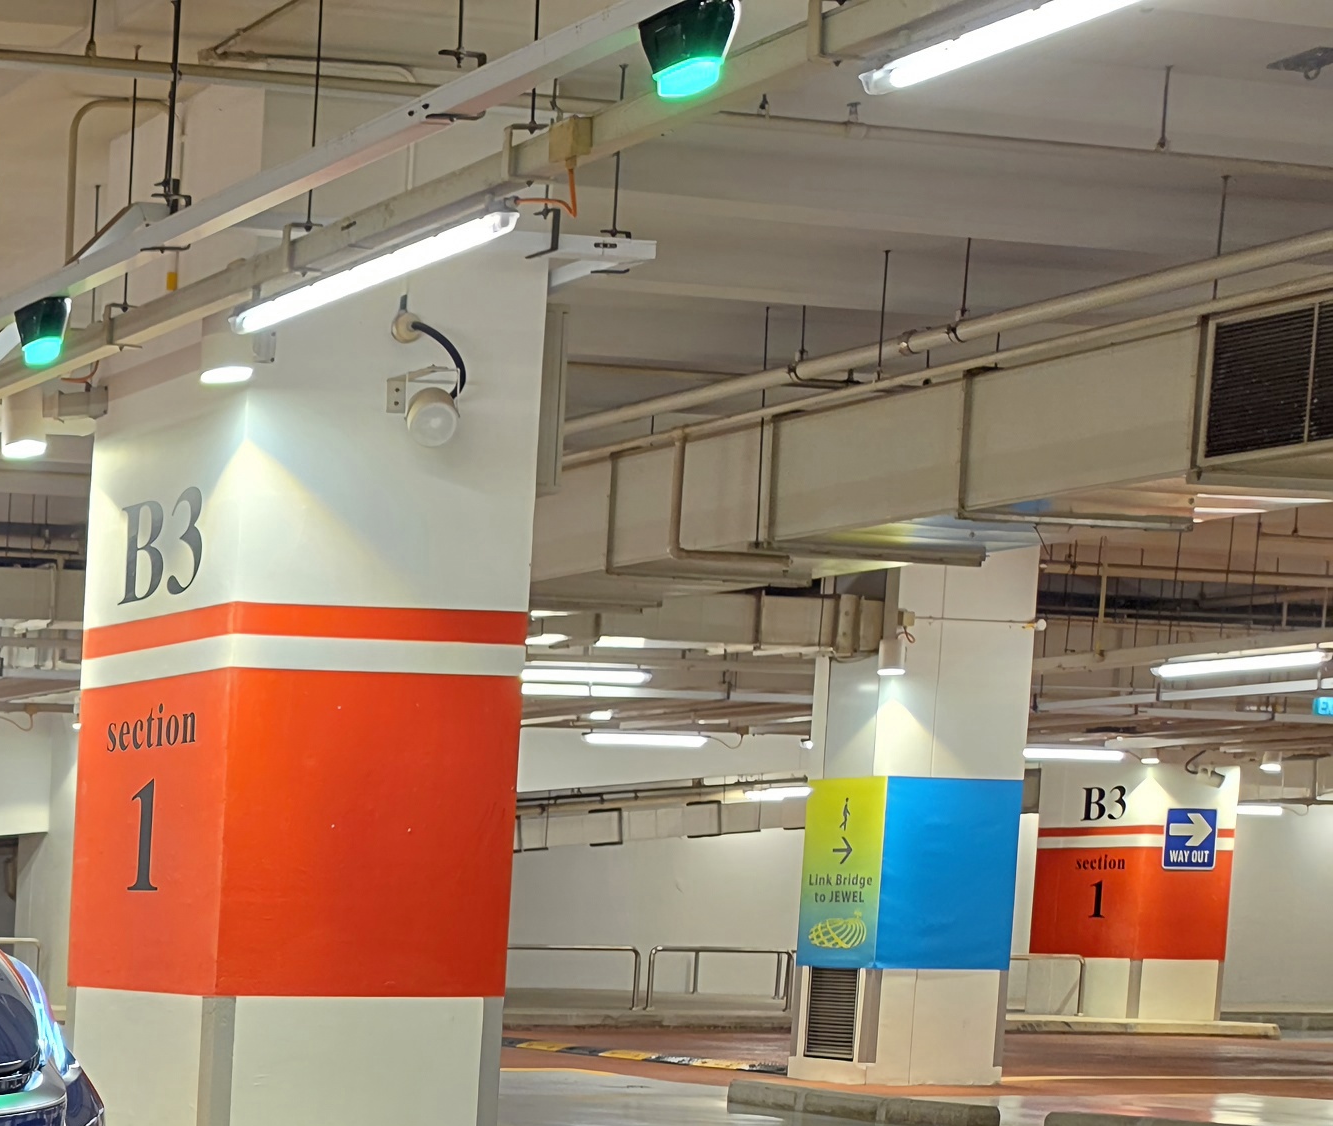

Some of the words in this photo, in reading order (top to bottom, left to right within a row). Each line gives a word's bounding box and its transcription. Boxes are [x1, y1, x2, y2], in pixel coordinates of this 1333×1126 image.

[117, 486, 203, 606] B3
[106, 703, 197, 753] section
[1080, 785, 1127, 822] B3
[126, 777, 158, 892] 1
[1075, 854, 1126, 871] section
[1169, 849, 1190, 863] WAY
[1191, 849, 1210, 863] OUT
[808, 873, 833, 886] Link
[835, 873, 873, 889] Bridge
[814, 892, 826, 903] to
[829, 890, 865, 903] JEWEL
[1088, 880, 1105, 919] 1
